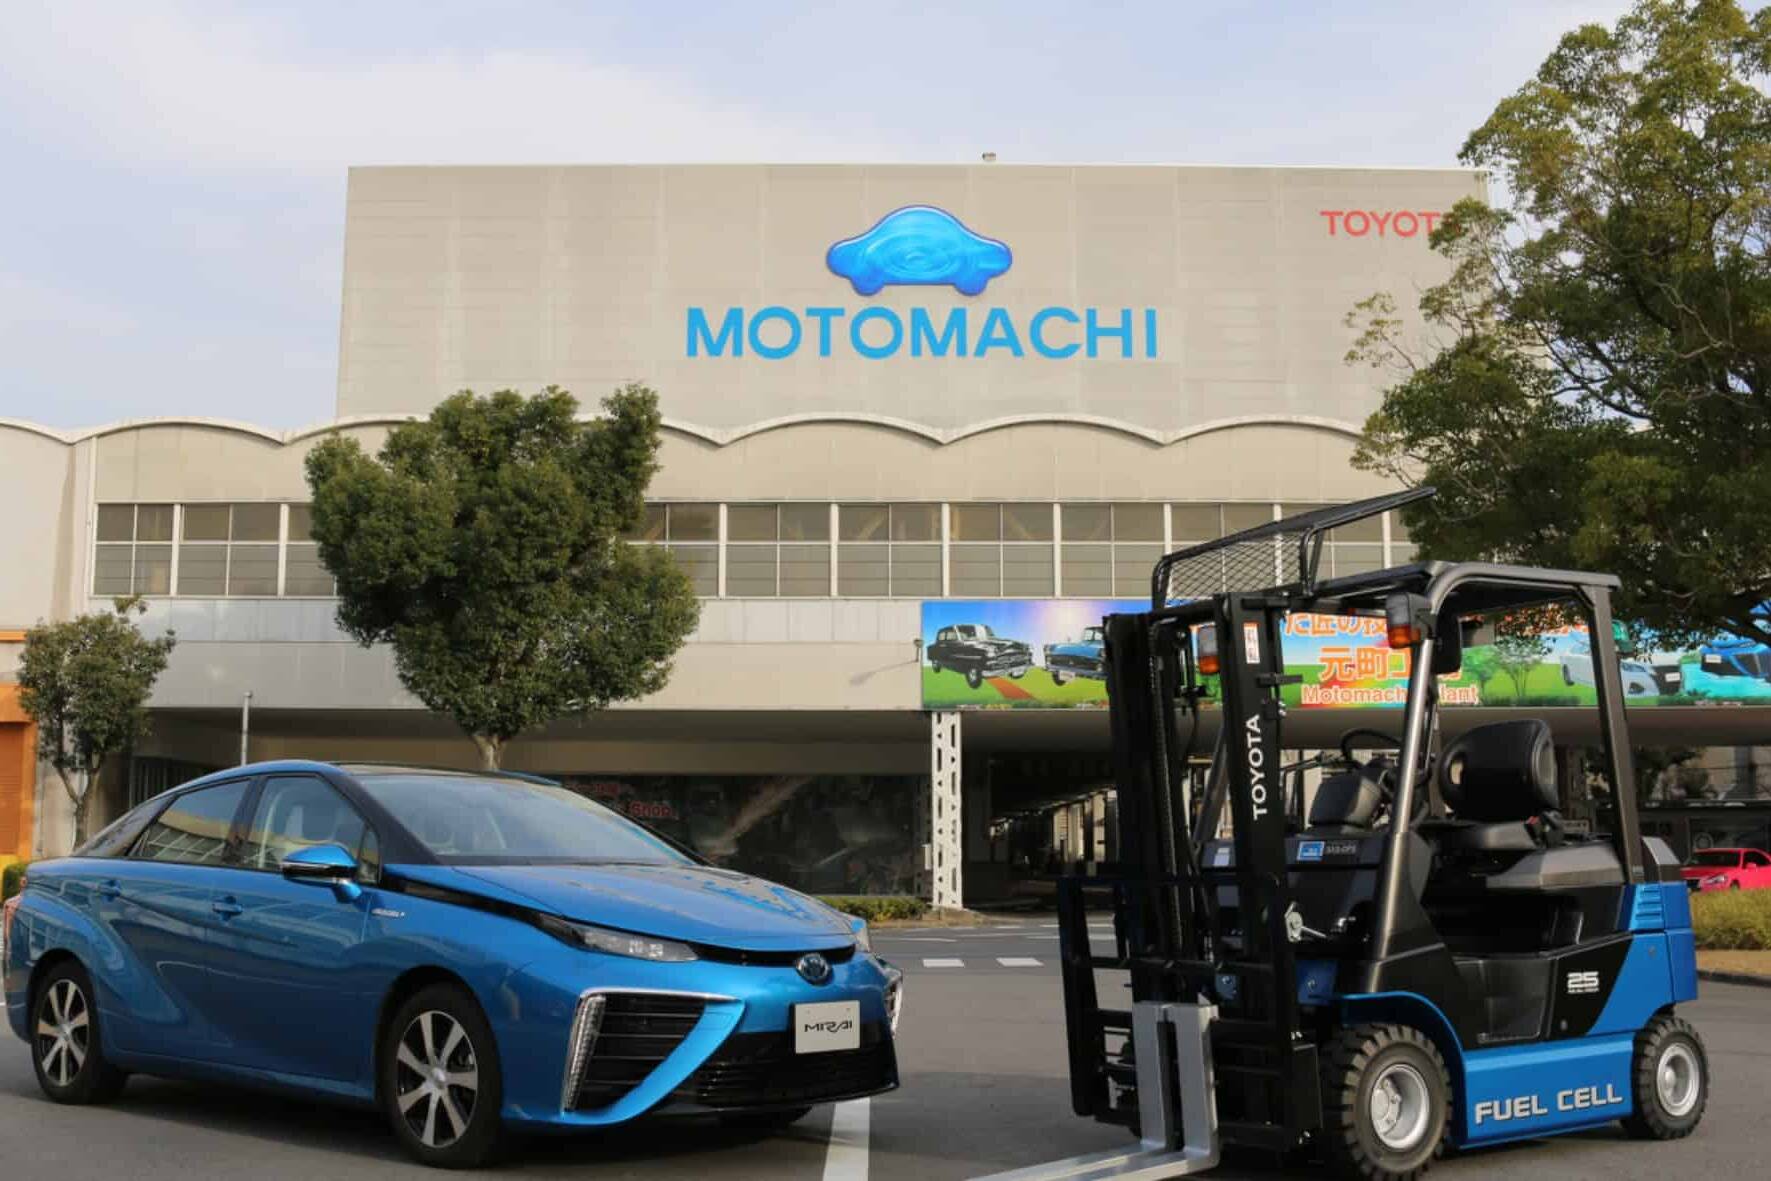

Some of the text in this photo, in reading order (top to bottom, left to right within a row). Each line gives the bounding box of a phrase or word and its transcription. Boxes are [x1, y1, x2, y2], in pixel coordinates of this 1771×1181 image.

[1319, 209, 1462, 237] TOYOT
[686, 306, 1158, 360] MOTOMACHI
[1319, 647, 1461, 682] 元町工
[1302, 683, 1408, 705] Motomach
[1245, 714, 1268, 820] TOYOTA
[1567, 971, 1599, 988] 25
[804, 1020, 853, 1033] MIRAI
[1475, 1083, 1623, 1125] FUEL CELL
